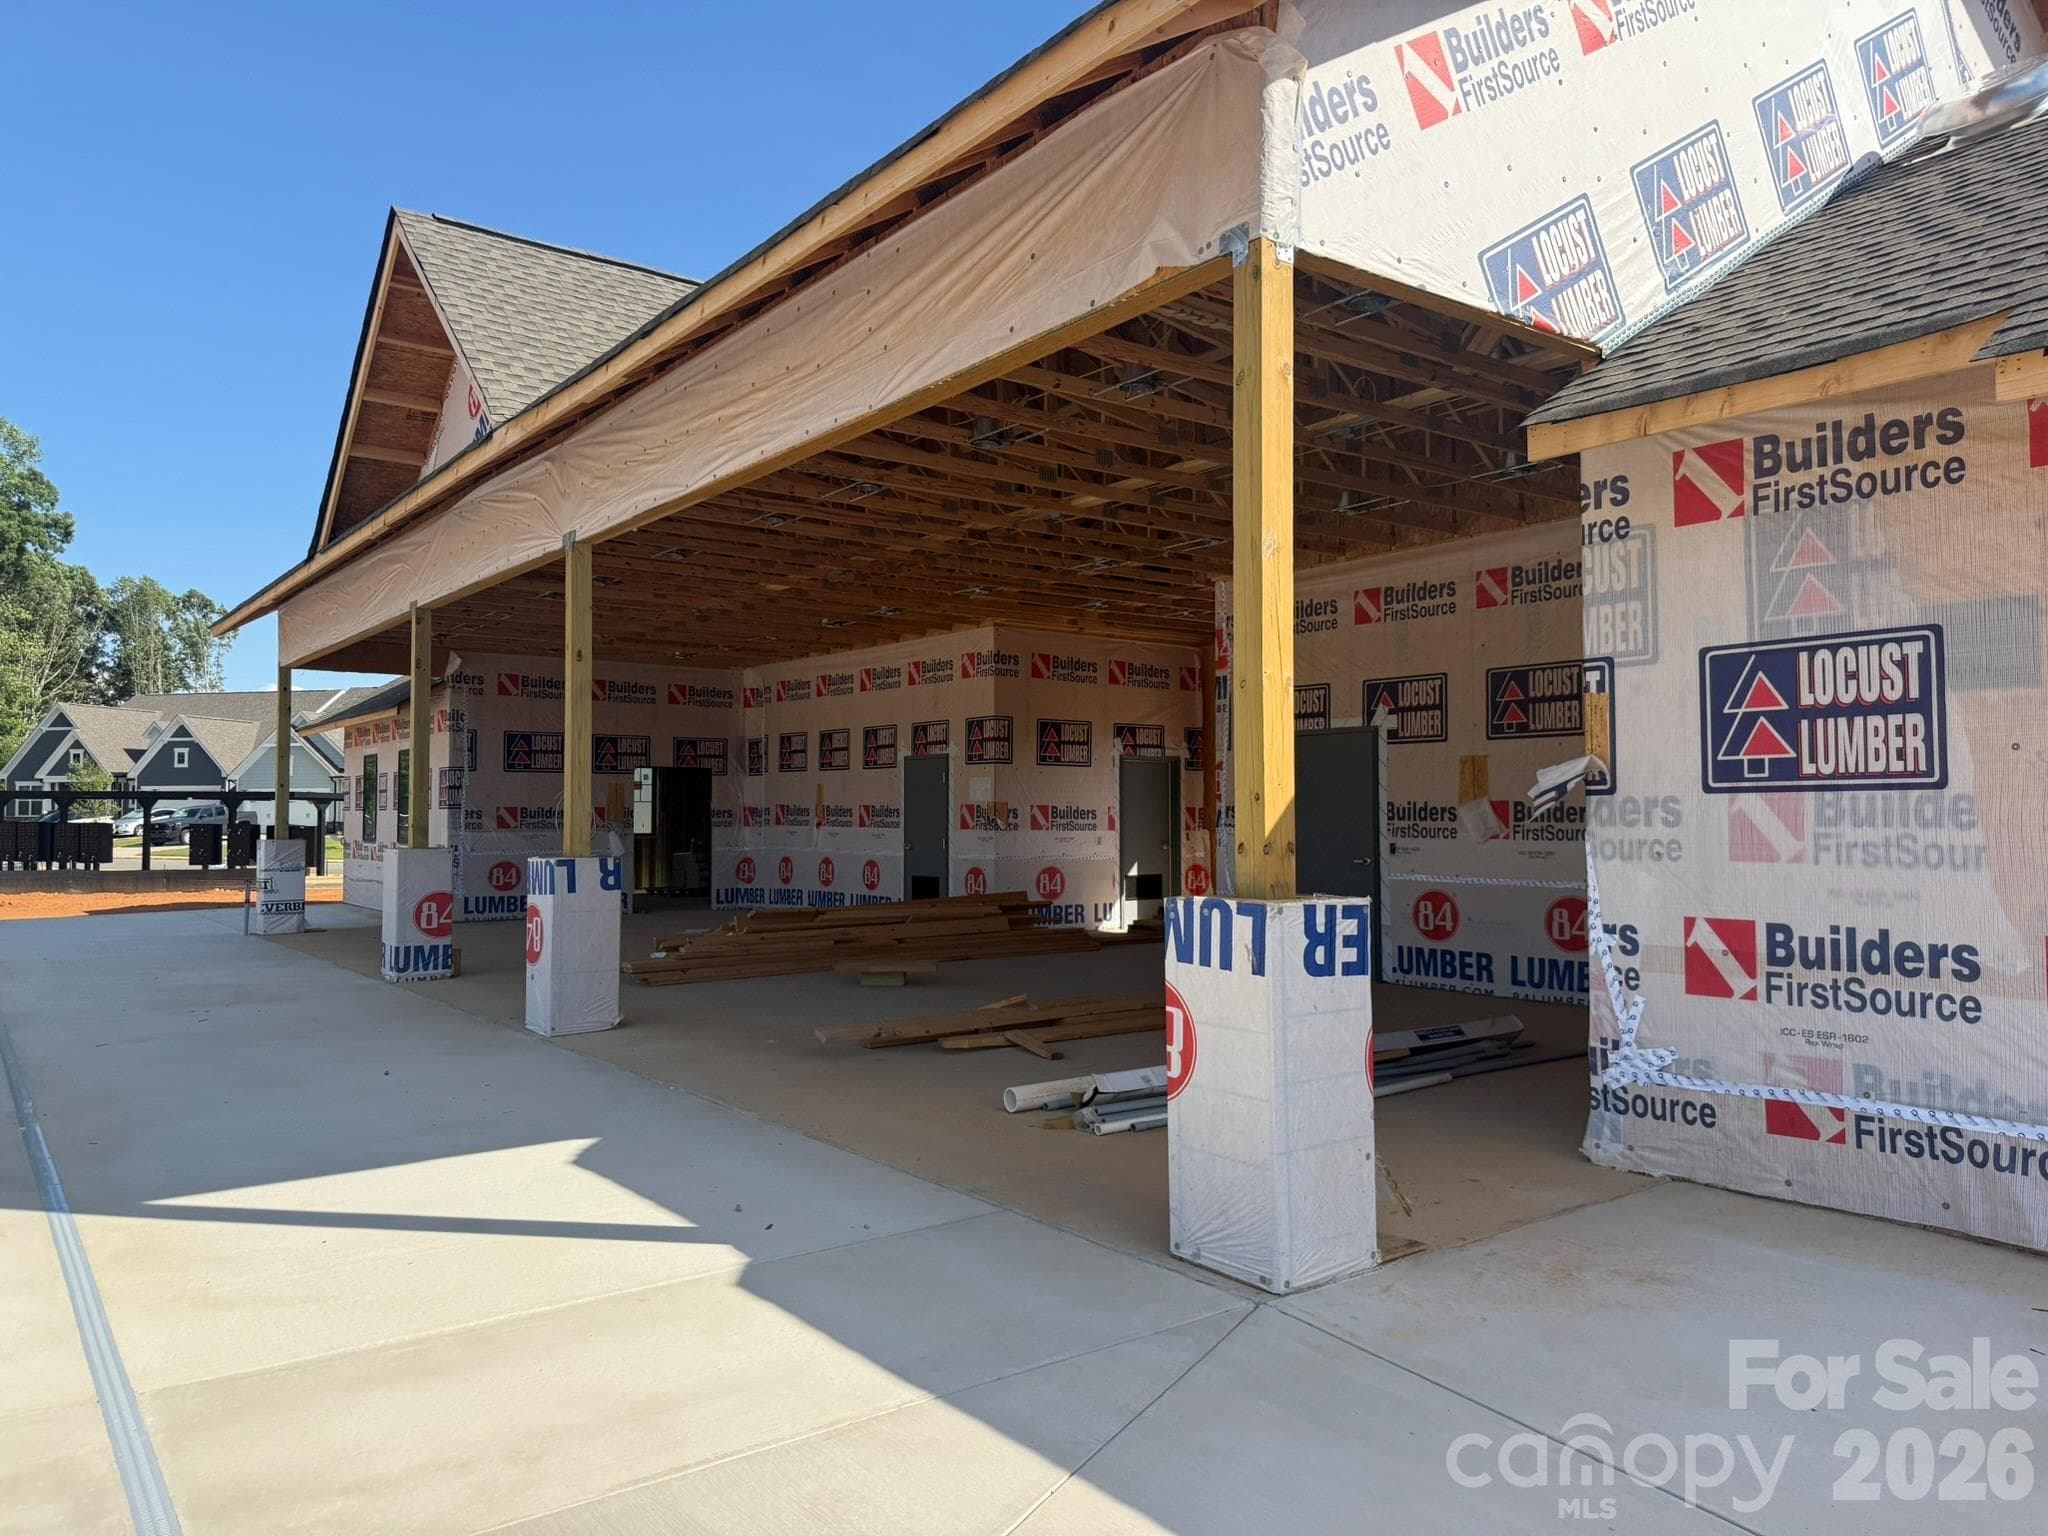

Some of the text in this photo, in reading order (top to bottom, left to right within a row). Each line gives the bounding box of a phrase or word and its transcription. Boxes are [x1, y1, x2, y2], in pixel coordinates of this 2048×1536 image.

[1444, 4, 1550, 75] Builders
[1460, 47, 1561, 112] FirstSource
[1672, 134, 1725, 204] LOCUST
[1689, 188, 1744, 260] LUMBER
[1531, 208, 1596, 287] LOCUST
[1753, 406, 1965, 479] Builders
[1753, 455, 1966, 516] FirstSource
[1384, 581, 1456, 606] Builders
[1384, 601, 1457, 624] FirstSource
[921, 659, 954, 675] Builders
[976, 650, 1020, 666] Builders
[1052, 656, 1098, 674] Builders
[1052, 669, 1098, 685] FirstSource
[1127, 662, 1170, 681] Builders
[1127, 676, 1170, 691] FirstSource
[1528, 666, 1580, 698] LOCUST
[1799, 640, 1925, 707] LOCUST
[608, 681, 657, 697] Builders
[688, 686, 734, 700] Builders
[1399, 680, 1442, 707] LOCUST
[1399, 709, 1442, 738] LUMBER
[1528, 699, 1581, 731] LUMBER
[531, 735, 563, 752] LOCUST
[1800, 713, 1928, 776] LUMBER
[1051, 805, 1097, 821] Builders
[1051, 820, 1097, 832] FirstSource
[492, 869, 519, 886] 84
[780, 862, 791, 880] 84
[820, 862, 832, 882] 84
[865, 865, 878, 886] 84
[1039, 872, 1063, 895] 84
[769, 887, 804, 906] LUMBER
[1418, 900, 1455, 934] 84
[1392, 946, 1495, 983] UMBER
[1766, 922, 1982, 983] Builders
[1766, 972, 1983, 1025] FirstSource
